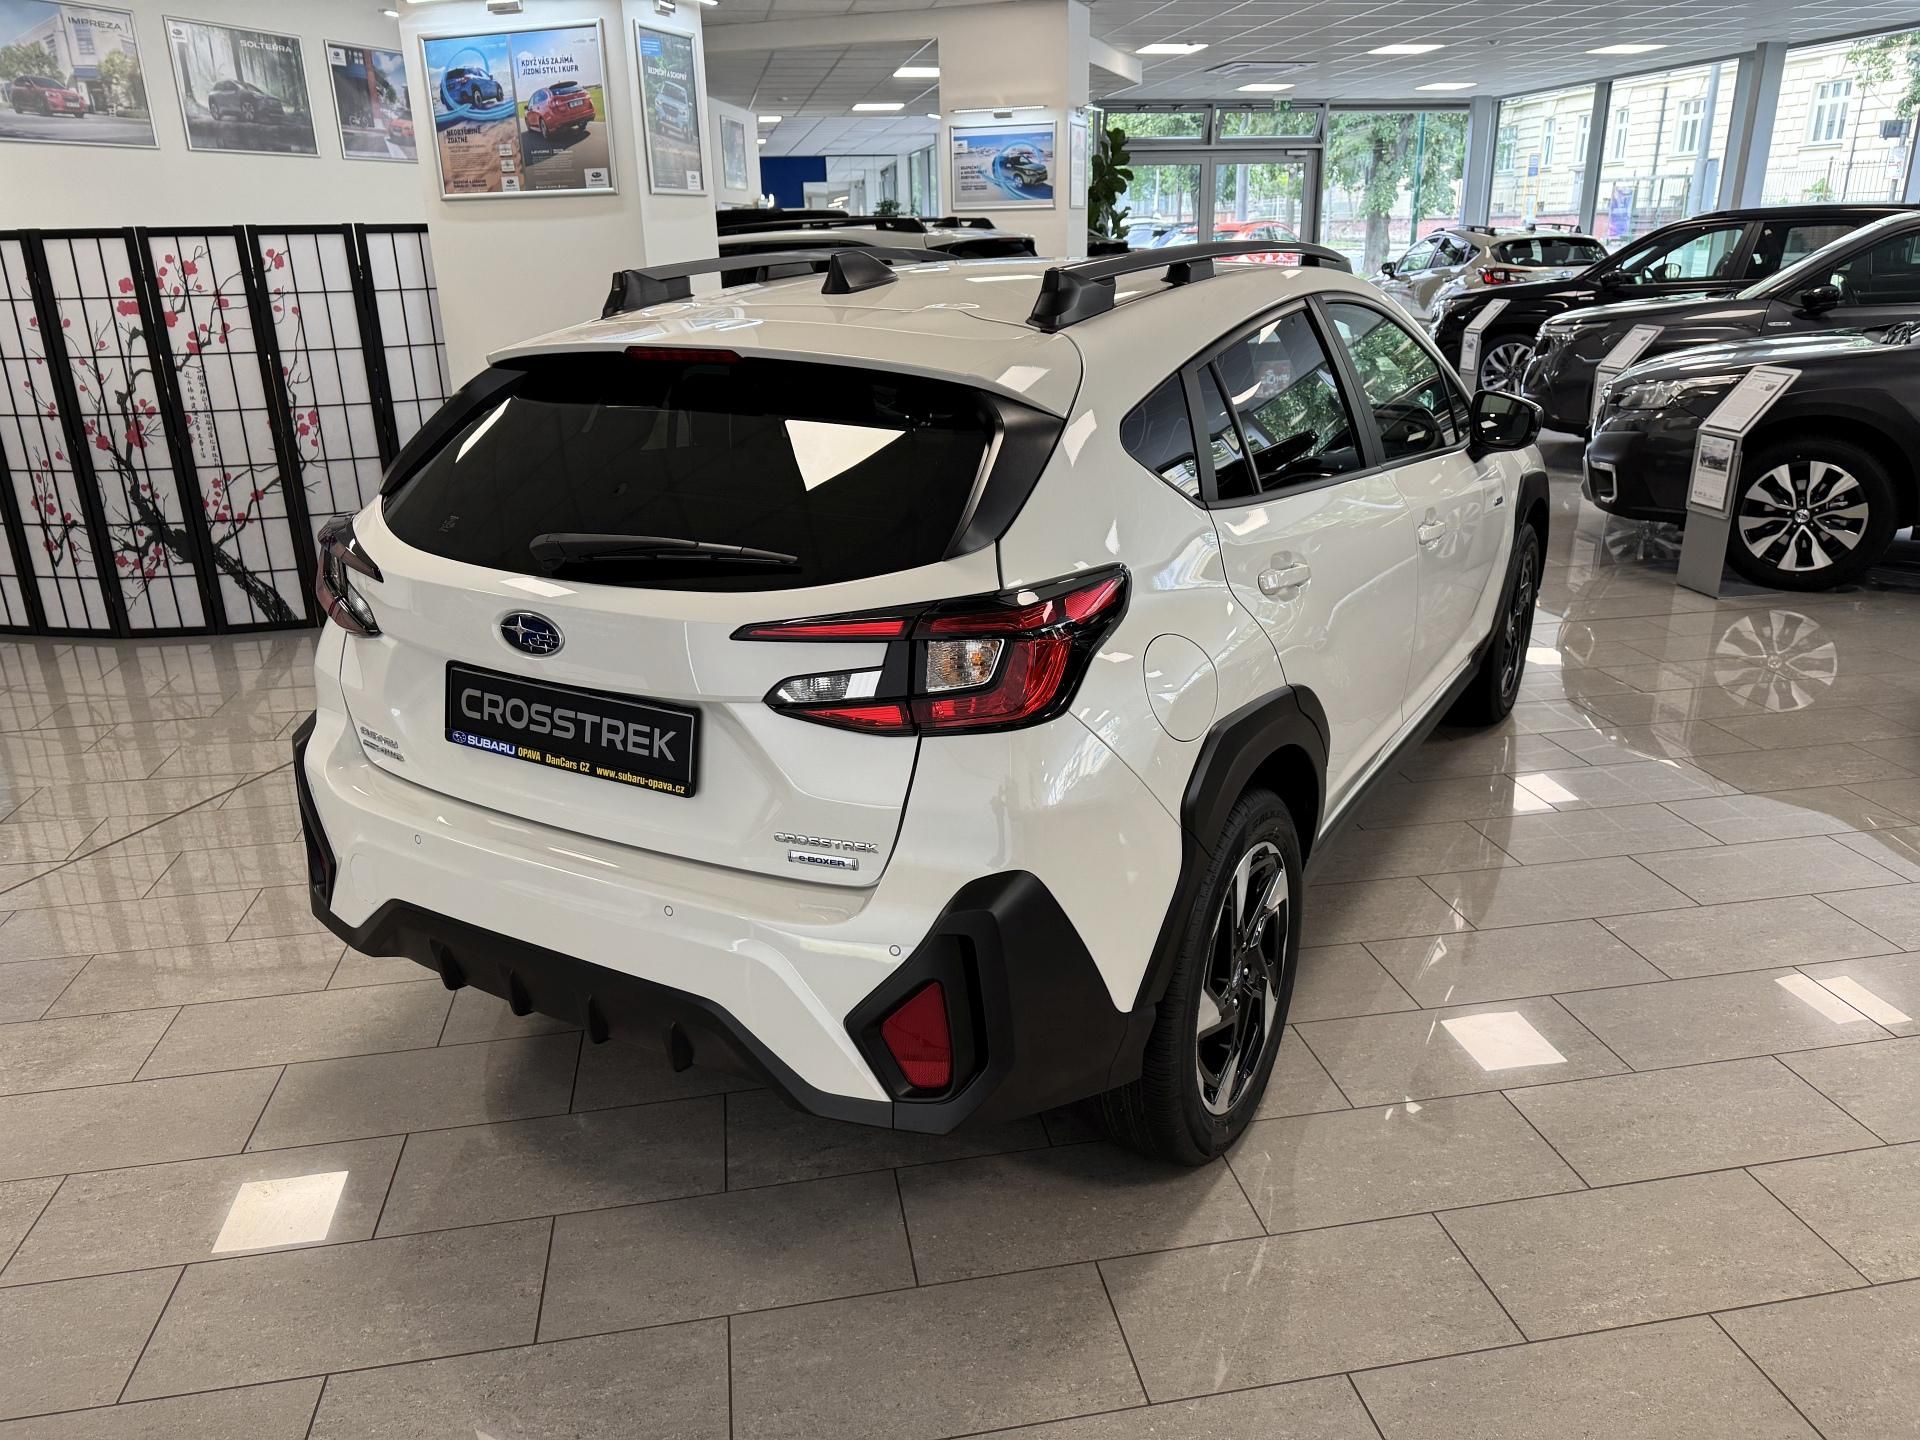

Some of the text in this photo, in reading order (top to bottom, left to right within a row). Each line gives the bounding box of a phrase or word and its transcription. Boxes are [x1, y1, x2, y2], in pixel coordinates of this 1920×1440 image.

[67, 16, 122, 31] IMPREZA
[239, 39, 293, 53] SOLTERRA
[542, 65, 558, 75] STYL
[561, 64, 580, 73] KUFR
[460, 687, 678, 762] CROSSTREK
[467, 734, 685, 794] SUBARU OPAVA DanCars CZ www.subaru-opava.cz
[773, 831, 879, 854] CROSSTREK
[798, 855, 846, 867] e-BOXER
